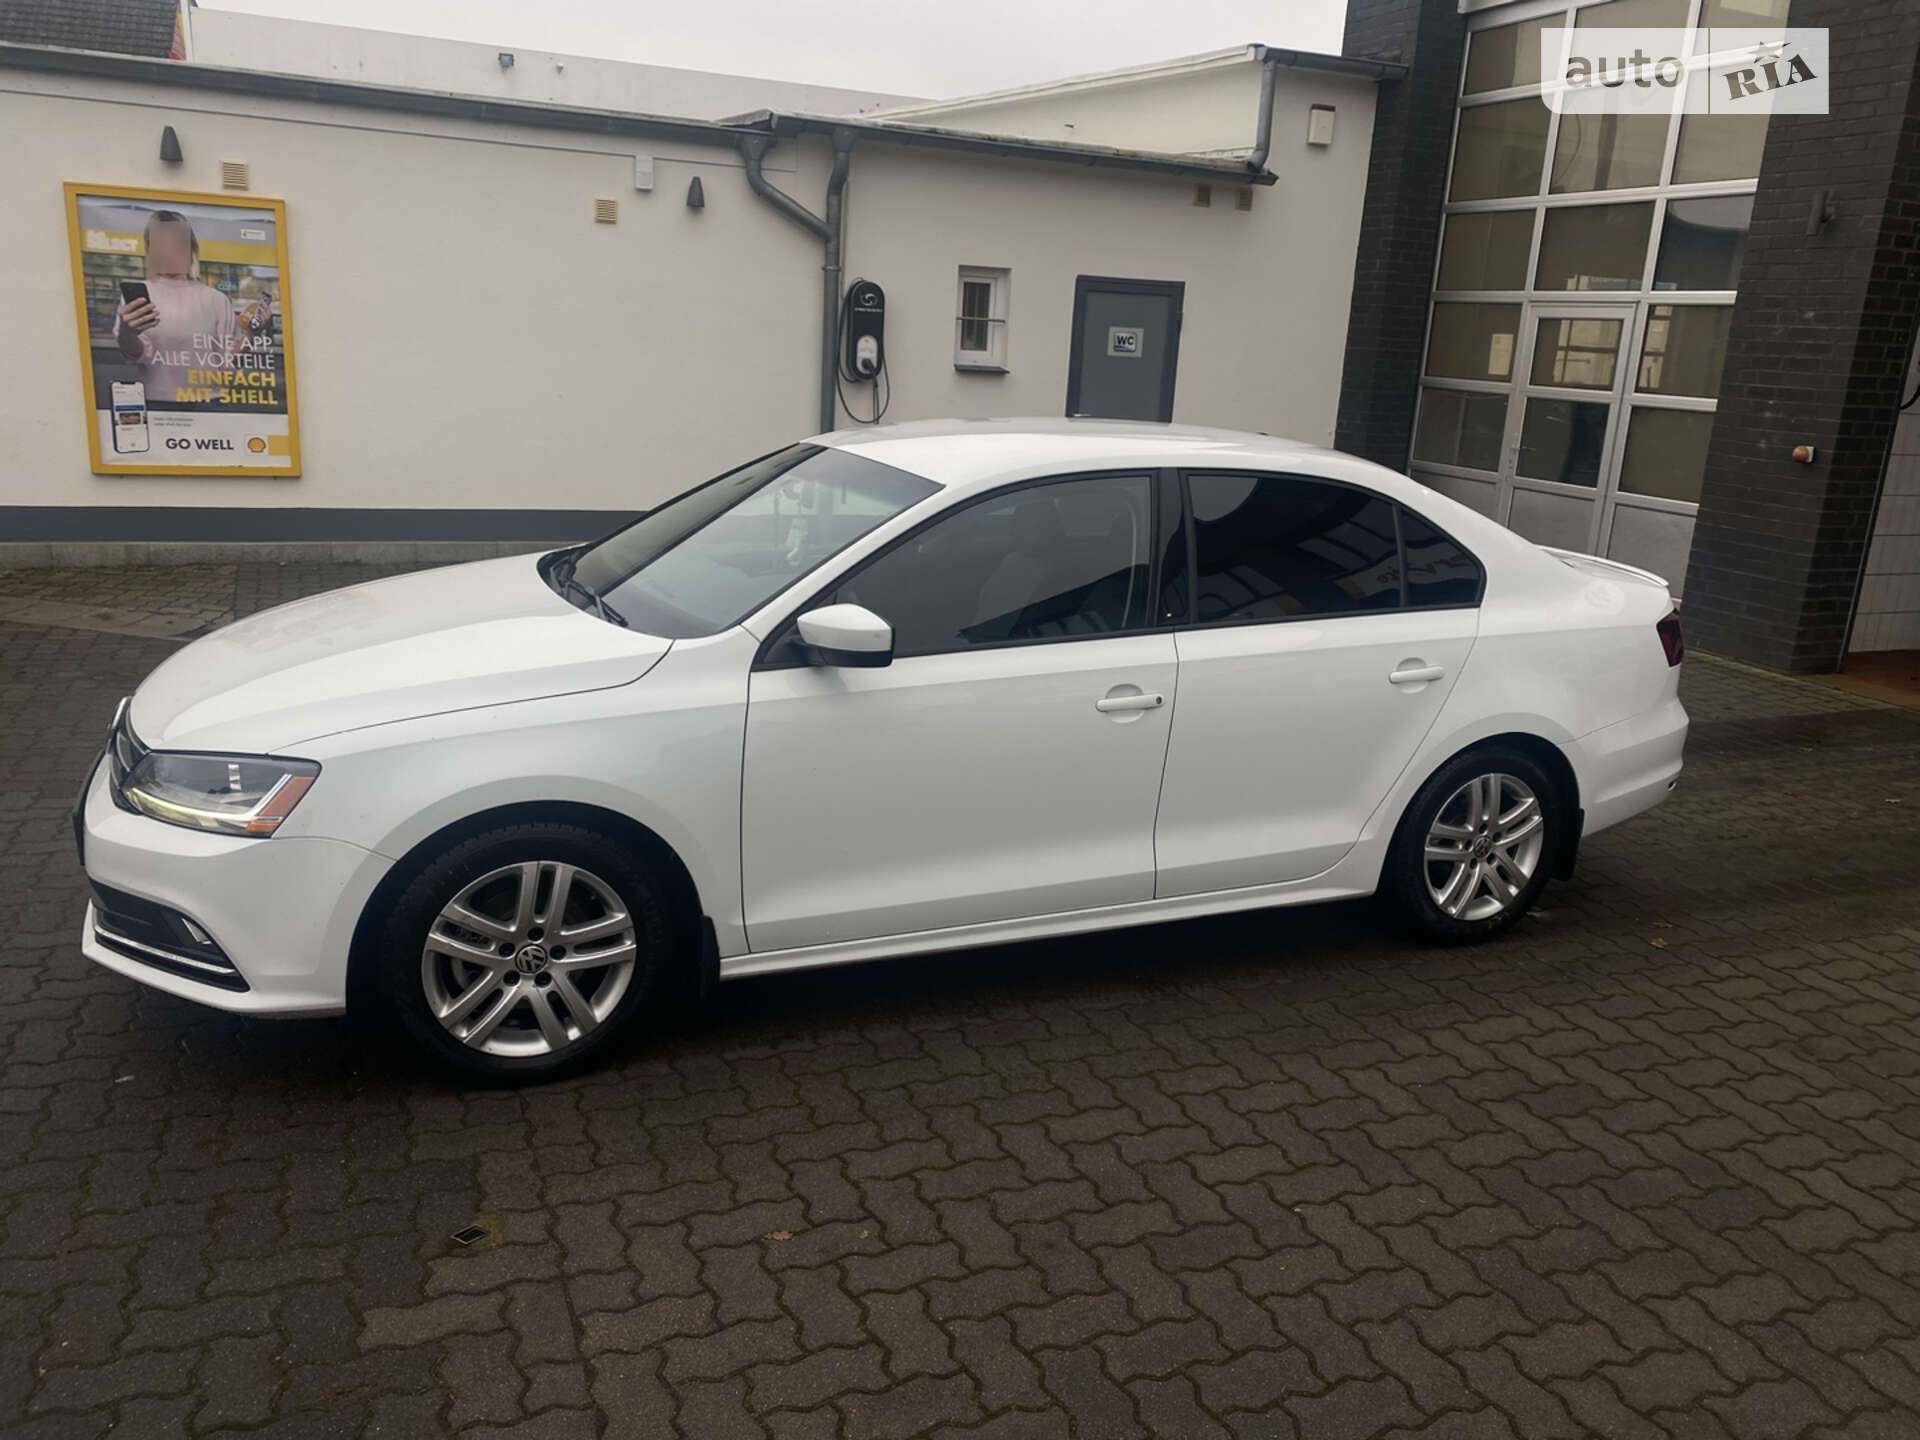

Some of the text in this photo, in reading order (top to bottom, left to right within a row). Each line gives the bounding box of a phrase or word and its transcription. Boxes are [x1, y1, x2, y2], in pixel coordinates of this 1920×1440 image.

[193, 333, 235, 350] EINE
[1116, 335, 1135, 346] WC
[151, 350, 276, 370] ALLE VORTEILE
[187, 369, 277, 387] EINFACH
[175, 387, 279, 405] MIT SHELL
[166, 438, 234, 450] GO WELL
